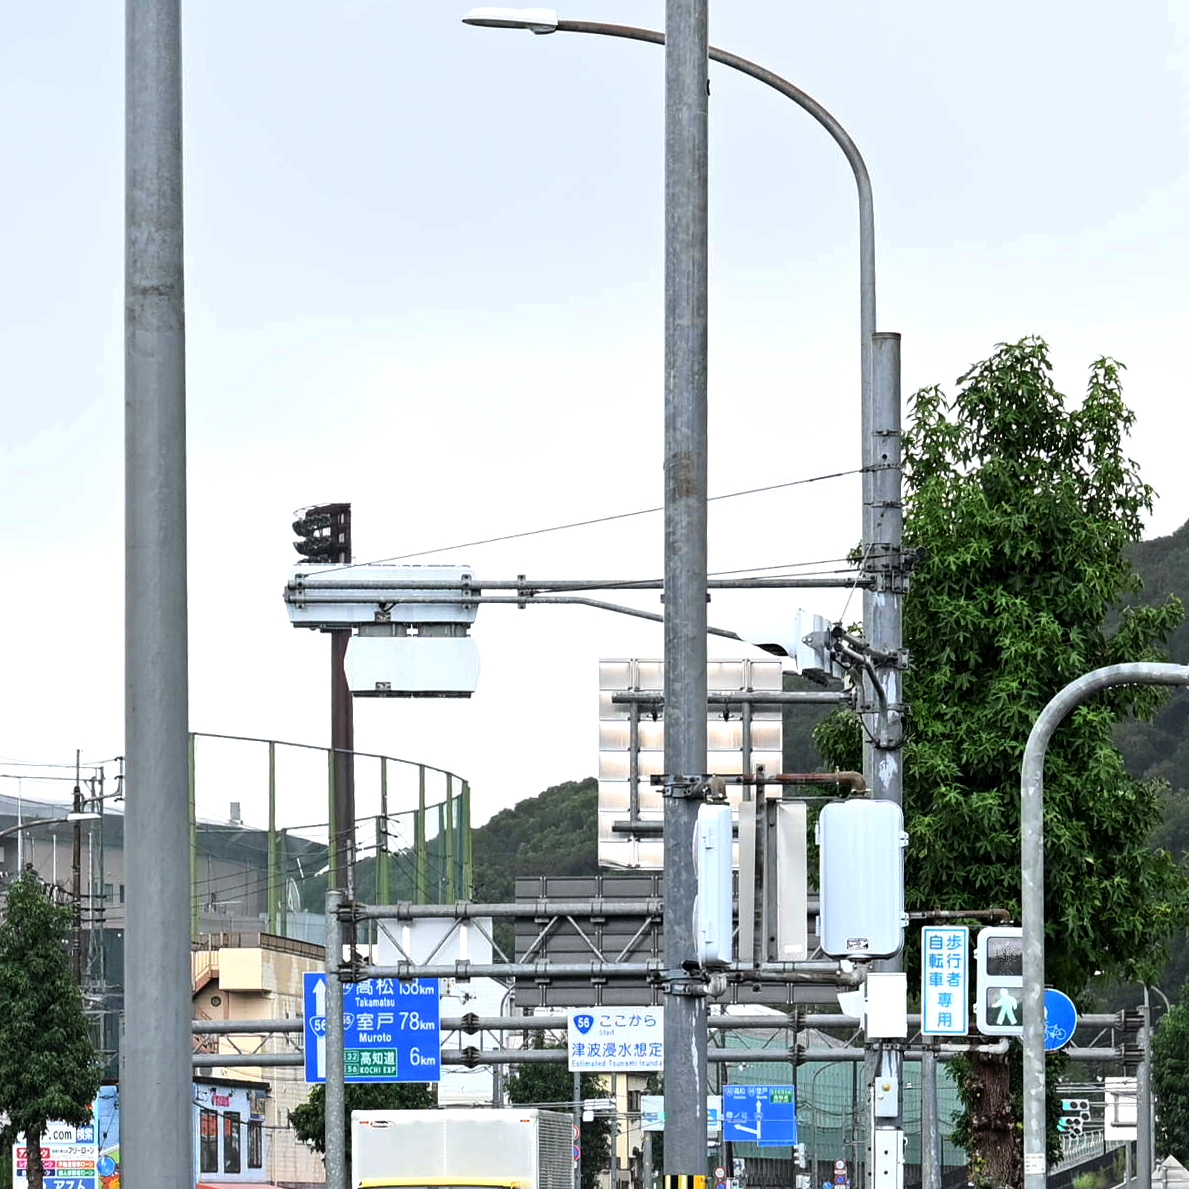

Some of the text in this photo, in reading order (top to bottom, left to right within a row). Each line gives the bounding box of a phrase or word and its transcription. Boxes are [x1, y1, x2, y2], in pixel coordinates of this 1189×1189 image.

[929, 935, 944, 987] 自転車
[946, 935, 962, 987] 歩行者
[356, 977, 394, 995] 高松
[355, 997, 395, 1008] Takamatsu
[938, 992, 953, 1028] 専用
[356, 1013, 394, 1030] 室戸
[399, 1012, 435, 1030] 78km
[578, 1014, 657, 1029] 56 ここから
[359, 1033, 392, 1043] Muroto
[360, 1051, 395, 1065] 高知道
[409, 1047, 436, 1066] 6km
[571, 1042, 663, 1058] 津波浸水想定
[360, 1066, 380, 1074] KOCHI
[383, 1066, 395, 1074] EXP
